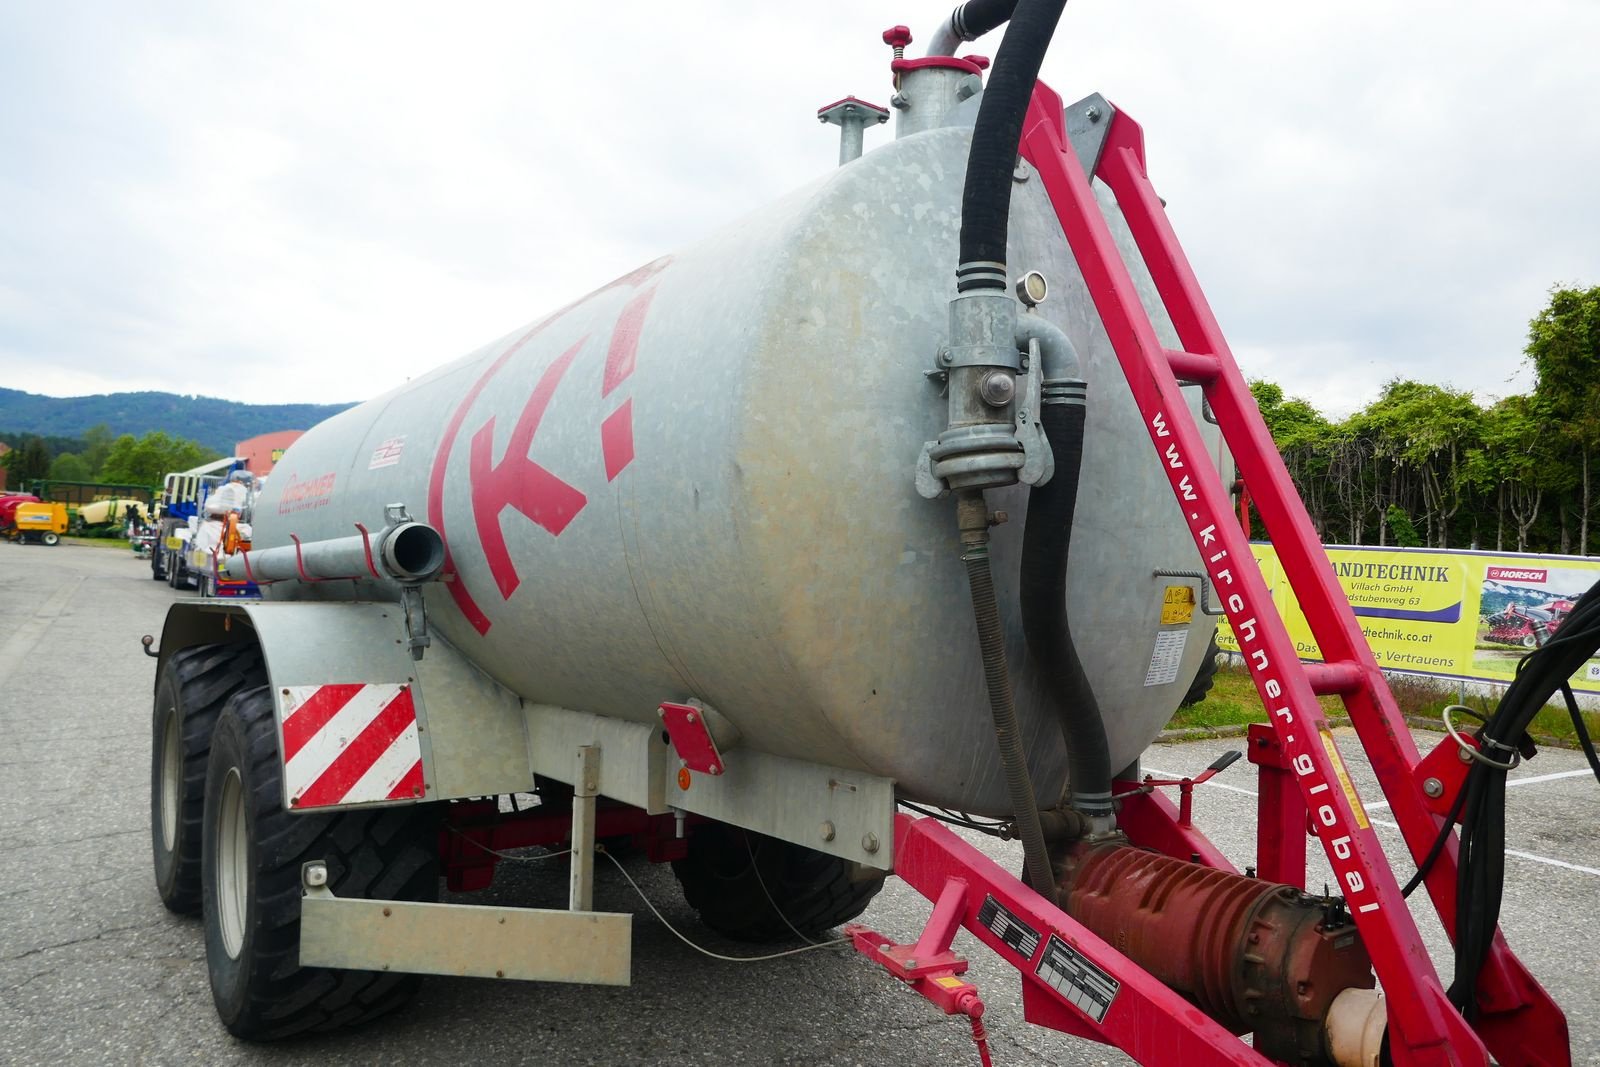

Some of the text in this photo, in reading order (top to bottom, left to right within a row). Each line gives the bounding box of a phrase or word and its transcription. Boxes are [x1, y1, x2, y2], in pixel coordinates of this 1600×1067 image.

[1331, 562, 1449, 583] ANDTECHNIK
[1500, 570, 1544, 580] HORSCH
[1351, 582, 1413, 593] Villach GmbH
[1345, 593, 1421, 606] dstubenweg 63
[1362, 627, 1433, 643] dtechnik.co.at
[1296, 642, 1317, 653] Das
[1386, 651, 1454, 667] Vertrauens
[1152, 412, 1380, 914] www.kirchner.global
